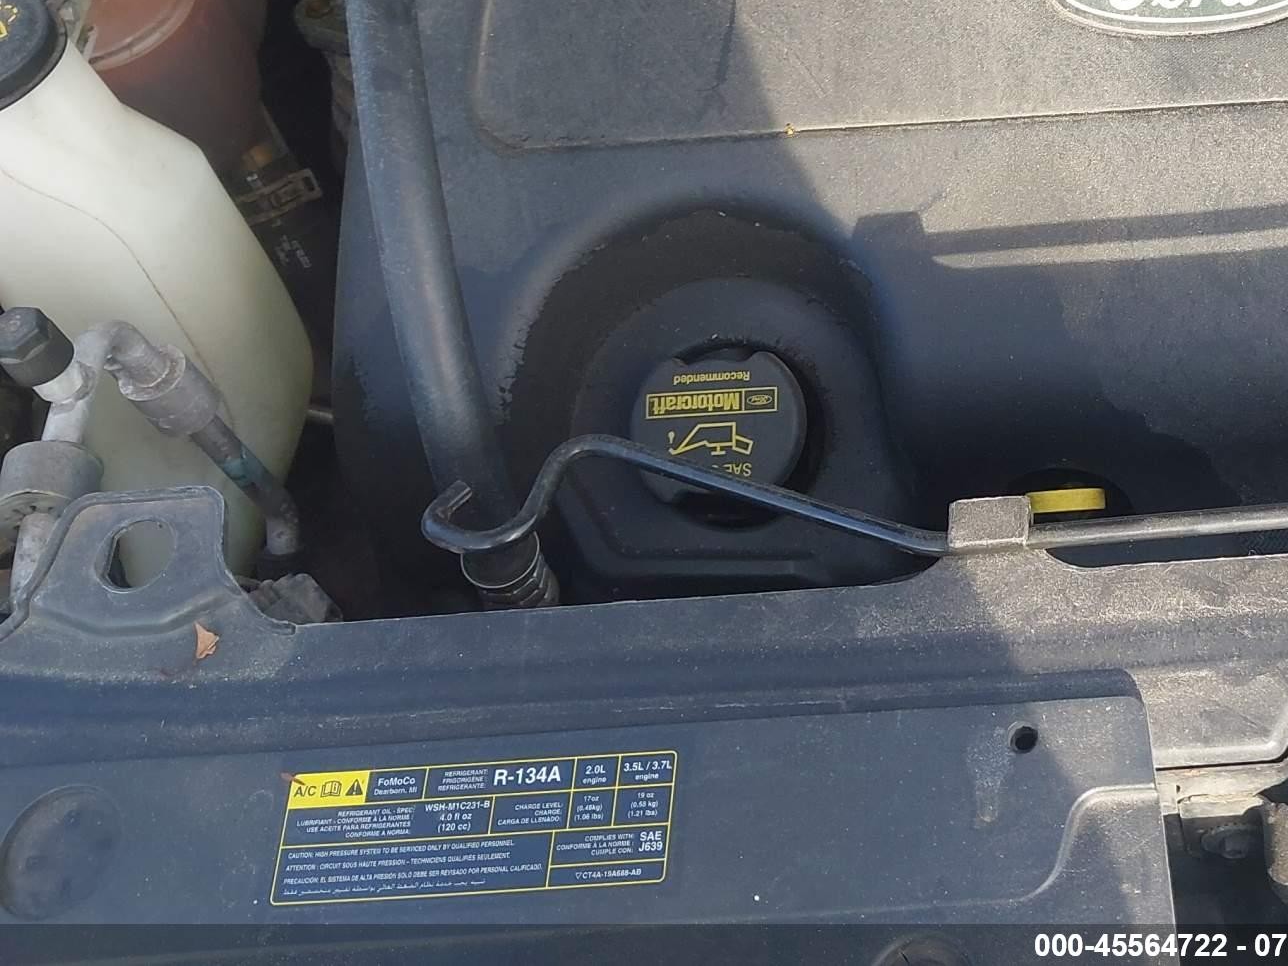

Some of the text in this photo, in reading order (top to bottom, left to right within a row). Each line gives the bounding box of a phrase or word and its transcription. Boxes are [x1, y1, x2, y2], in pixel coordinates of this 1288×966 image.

[673, 371, 751, 386] Recommended
[649, 392, 741, 415] Motorcraft
[585, 765, 606, 774] 2.0L
[623, 762, 645, 771] 3.5L
[651, 760, 672, 770] 3.7L
[493, 765, 562, 785] R-134A
[582, 776, 606, 784] engine
[377, 776, 415, 786] FoMoCo
[293, 785, 316, 797] A/C
[424, 800, 490, 811] WSH-M1C231-B
[439, 813, 452, 821] 4.0
[437, 822, 471, 832] (120 cc)
[639, 830, 662, 841] SAE
[638, 841, 663, 851] J639
